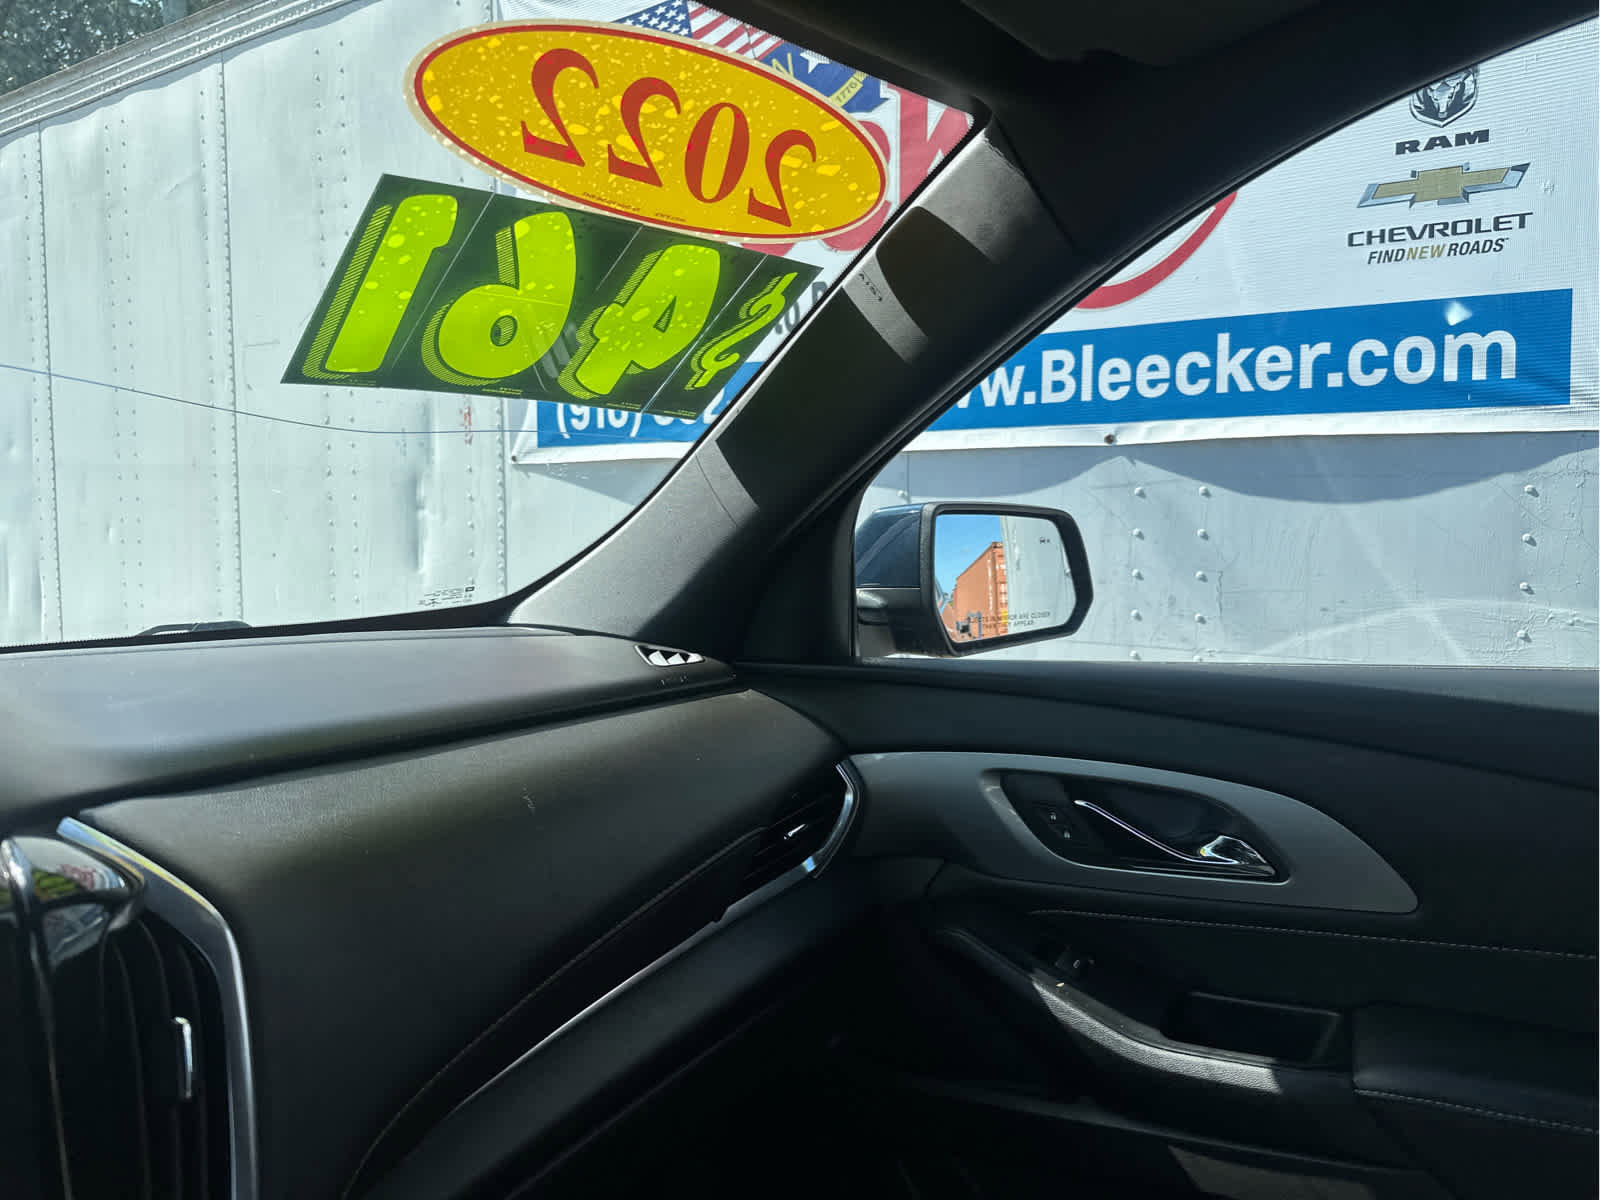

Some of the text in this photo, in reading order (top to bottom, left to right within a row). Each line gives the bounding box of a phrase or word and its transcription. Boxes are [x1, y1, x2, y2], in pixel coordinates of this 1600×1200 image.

[1395, 129, 1489, 155] RAM
[1348, 212, 1533, 247] CHEVROLET
[1368, 249, 1405, 264] FIND
[1406, 244, 1446, 260] NEW
[956, 330, 1516, 408] w.Bleecker.com
